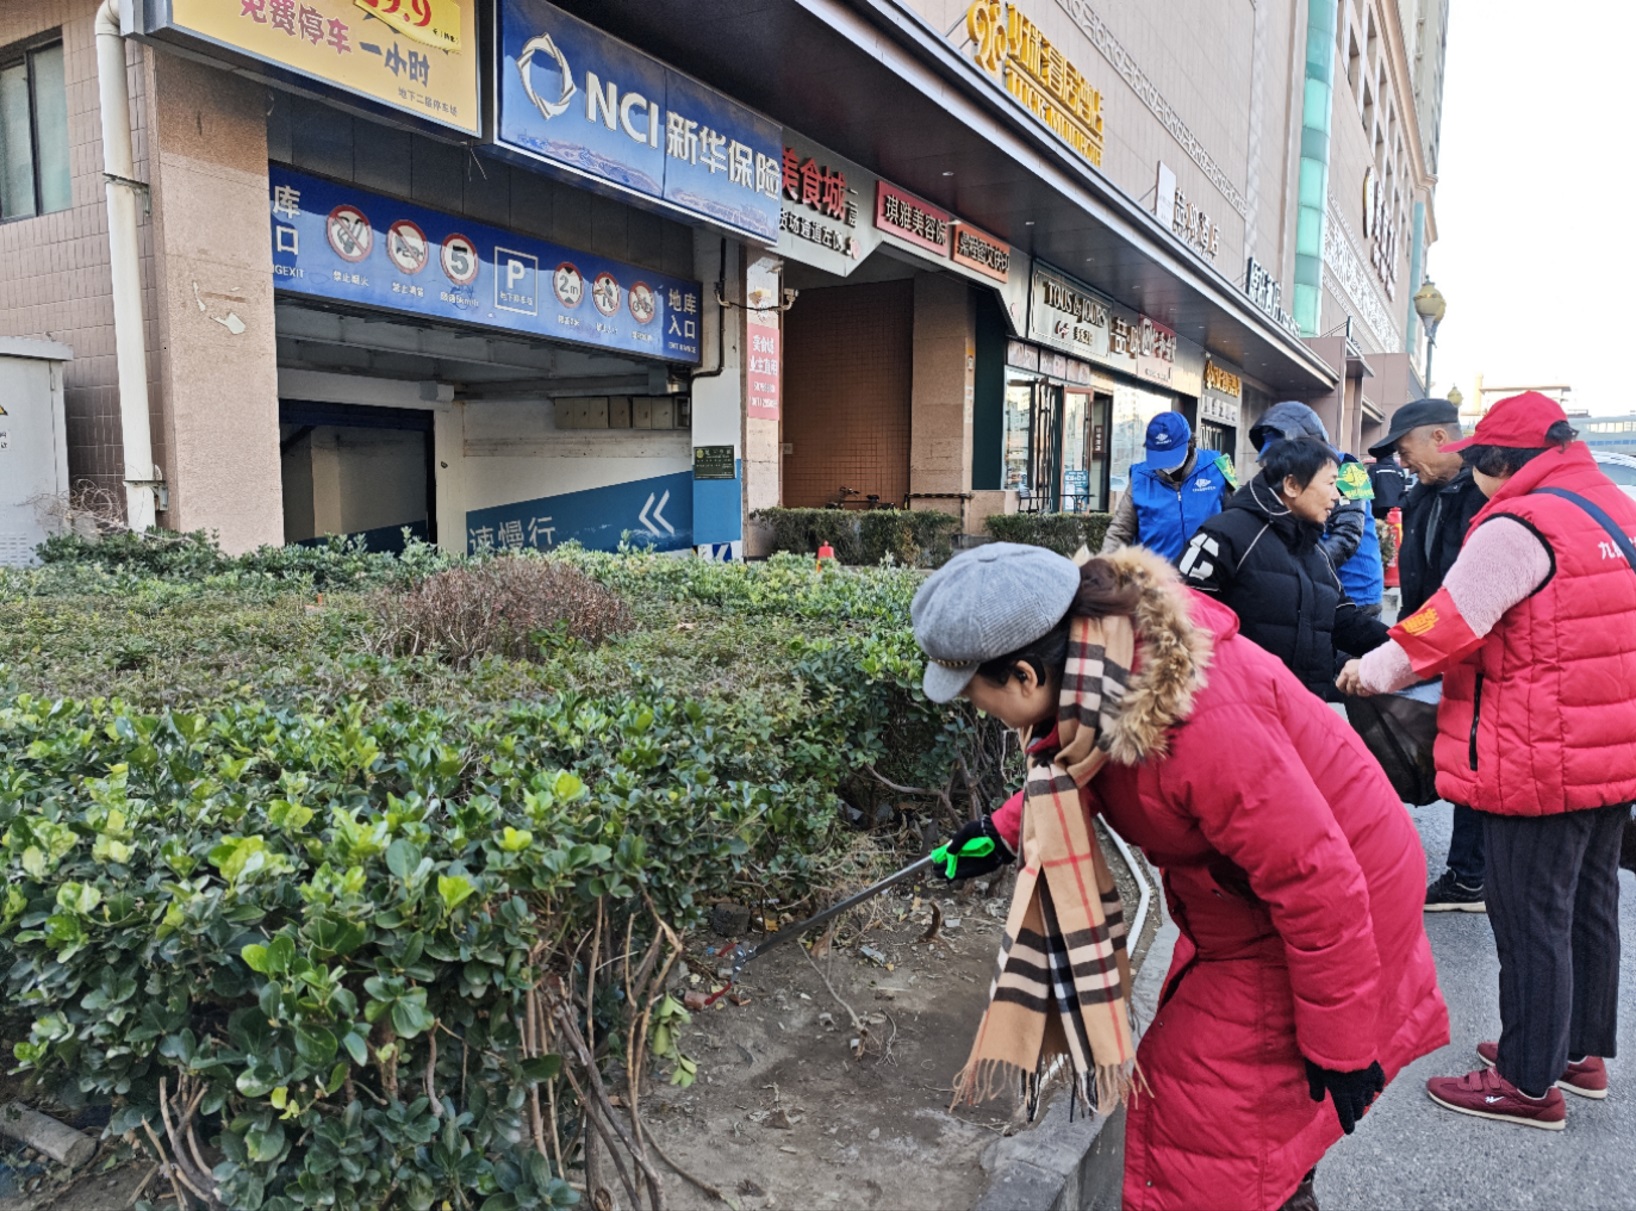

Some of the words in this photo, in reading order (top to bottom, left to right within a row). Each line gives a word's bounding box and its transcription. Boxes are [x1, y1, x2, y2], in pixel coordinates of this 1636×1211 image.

[240, 0, 352, 55] 免费停车
[359, 41, 431, 88] 一小时
[585, 70, 659, 149] NCI
[667, 111, 780, 200] 新华保险
[782, 146, 847, 222] 美食城
[272, 185, 301, 219] 库
[276, 225, 299, 256] 口
[451, 245, 469, 275] 5
[507, 259, 525, 290] P
[668, 288, 697, 315] 地库
[668, 315, 696, 339] 入口
